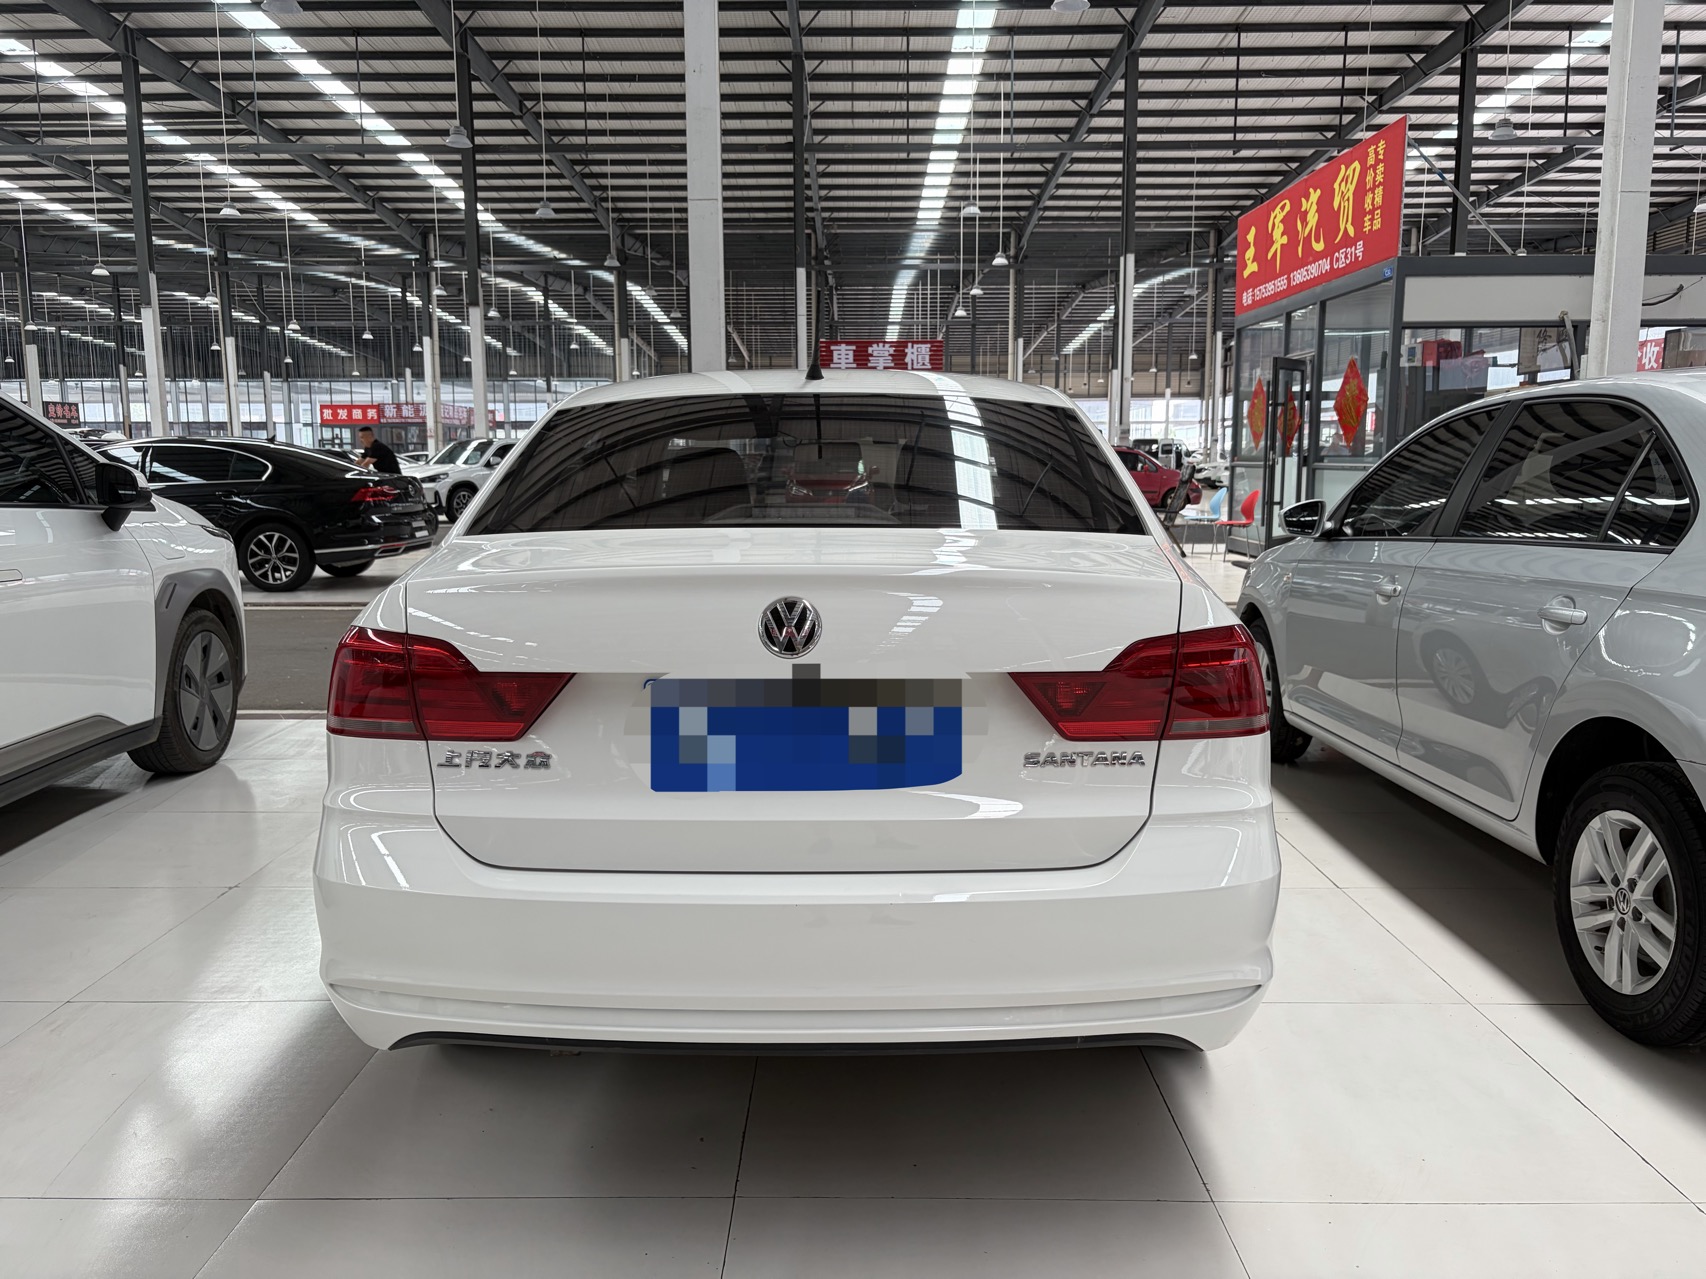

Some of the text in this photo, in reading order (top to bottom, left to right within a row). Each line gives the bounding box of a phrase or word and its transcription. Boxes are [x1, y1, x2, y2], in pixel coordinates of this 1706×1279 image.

[1363, 144, 1376, 234] 高价收车
[1372, 139, 1386, 231] 专卖精品
[1333, 240, 1364, 269] C区31号
[830, 343, 932, 370] 車掌櫃
[322, 408, 378, 420] 批发商务
[1023, 751, 1146, 768] SANTANA
